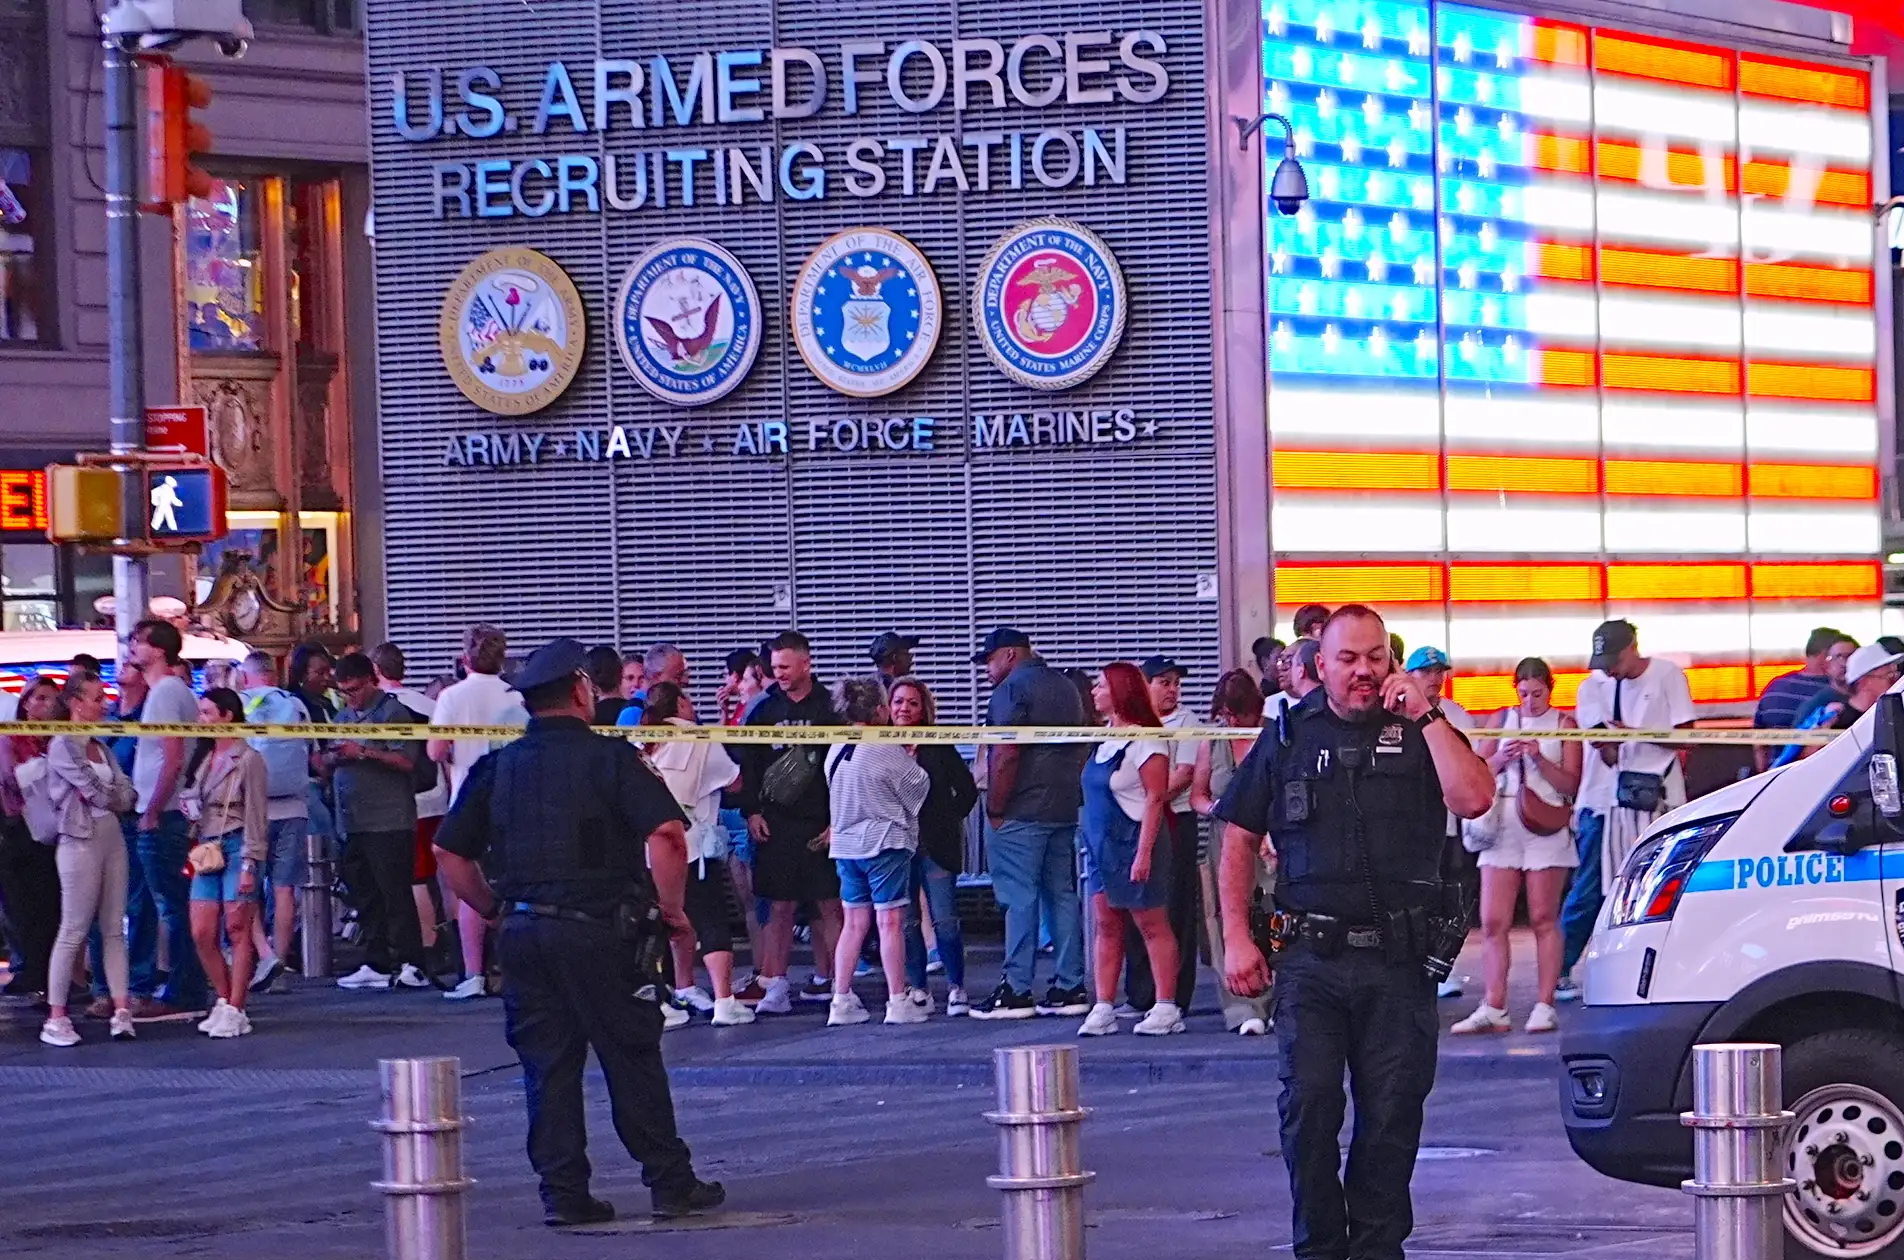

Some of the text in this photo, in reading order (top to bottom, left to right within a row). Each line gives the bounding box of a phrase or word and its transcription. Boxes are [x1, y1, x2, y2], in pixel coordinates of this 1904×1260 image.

[392, 30, 1169, 141] U.S. ARMED FORCES
[432, 128, 1128, 219] RECRUITING STATION
[627, 253, 678, 321] DEPARTMENT
[681, 253, 697, 265] OF
[723, 272, 746, 306] NAVY
[798, 235, 934, 342] DEPARTMENT OF THE AIR FORCE
[986, 233, 1111, 308] DEPARTMENT OF THE NAVY
[628, 323, 749, 392] UNITED STATES OF AMERICA
[989, 304, 1111, 373] UNITED STATES MARINE CORPS
[147, 412, 188, 423] STOPPING
[443, 408, 1136, 468] ARMY NAVY AIR FORCE MARINES
[1737, 854, 1841, 888] POLICE
